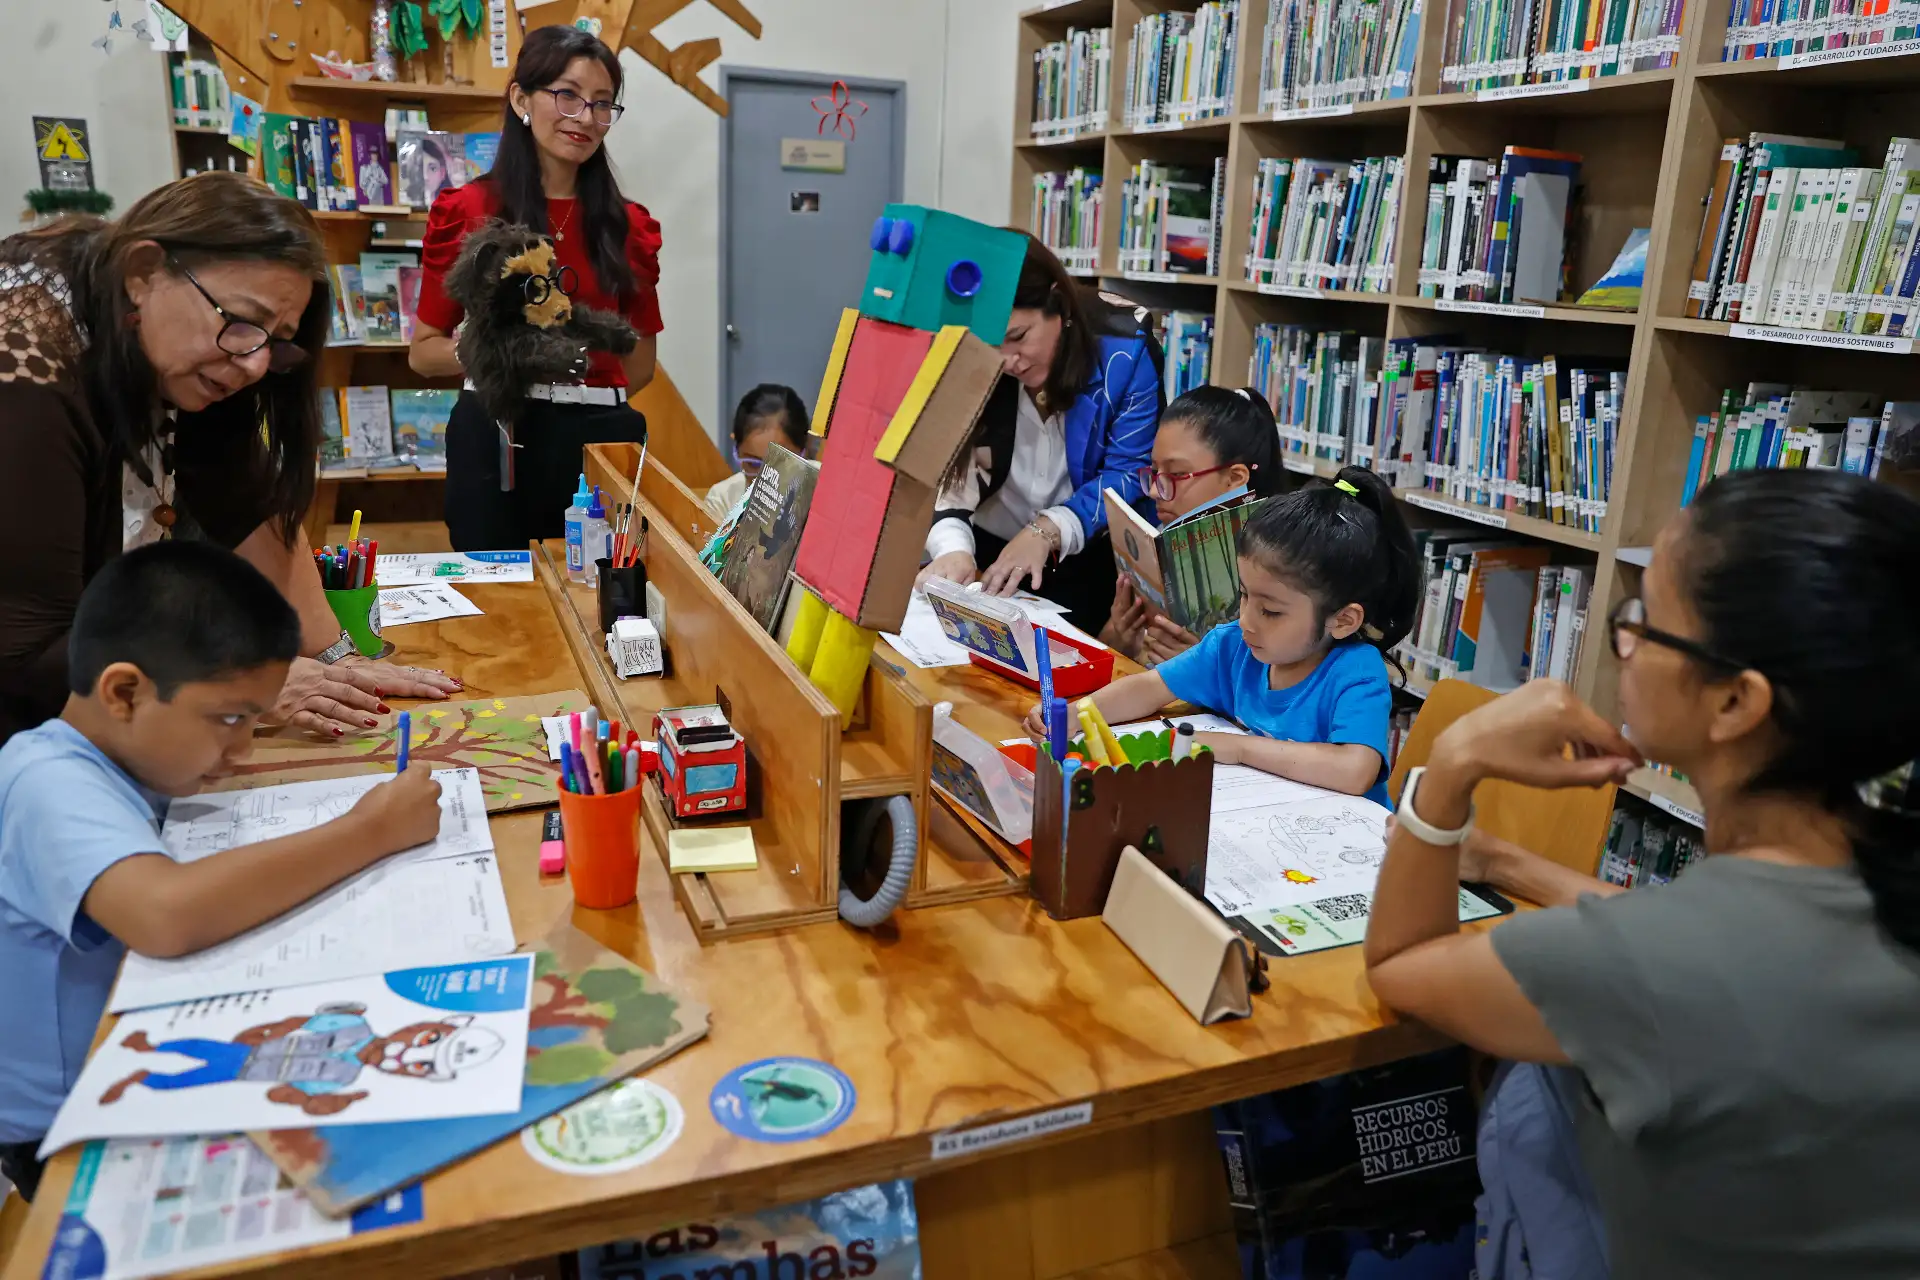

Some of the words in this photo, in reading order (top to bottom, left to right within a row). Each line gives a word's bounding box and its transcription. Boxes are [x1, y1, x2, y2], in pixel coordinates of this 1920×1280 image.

[1808, 50, 1855, 63] DESARROLLO
[1856, 49, 1861, 57] Y
[1863, 44, 1903, 56] CIUDADES
[1747, 328, 1756, 336] DS
[1762, 330, 1804, 341] DESARROLLO
[1811, 335, 1845, 345] CIUDADES
[1847, 337, 1895, 349] SOSTENIBLES
[962, 1124, 1029, 1148] Residuos
[1033, 1110, 1086, 1130] Sólidos
[1352, 1097, 1449, 1134] RECURSOS
[1361, 1154, 1388, 1177] EN
[1390, 1150, 1415, 1170] EL
[1415, 1130, 1461, 1164] PERÚ
